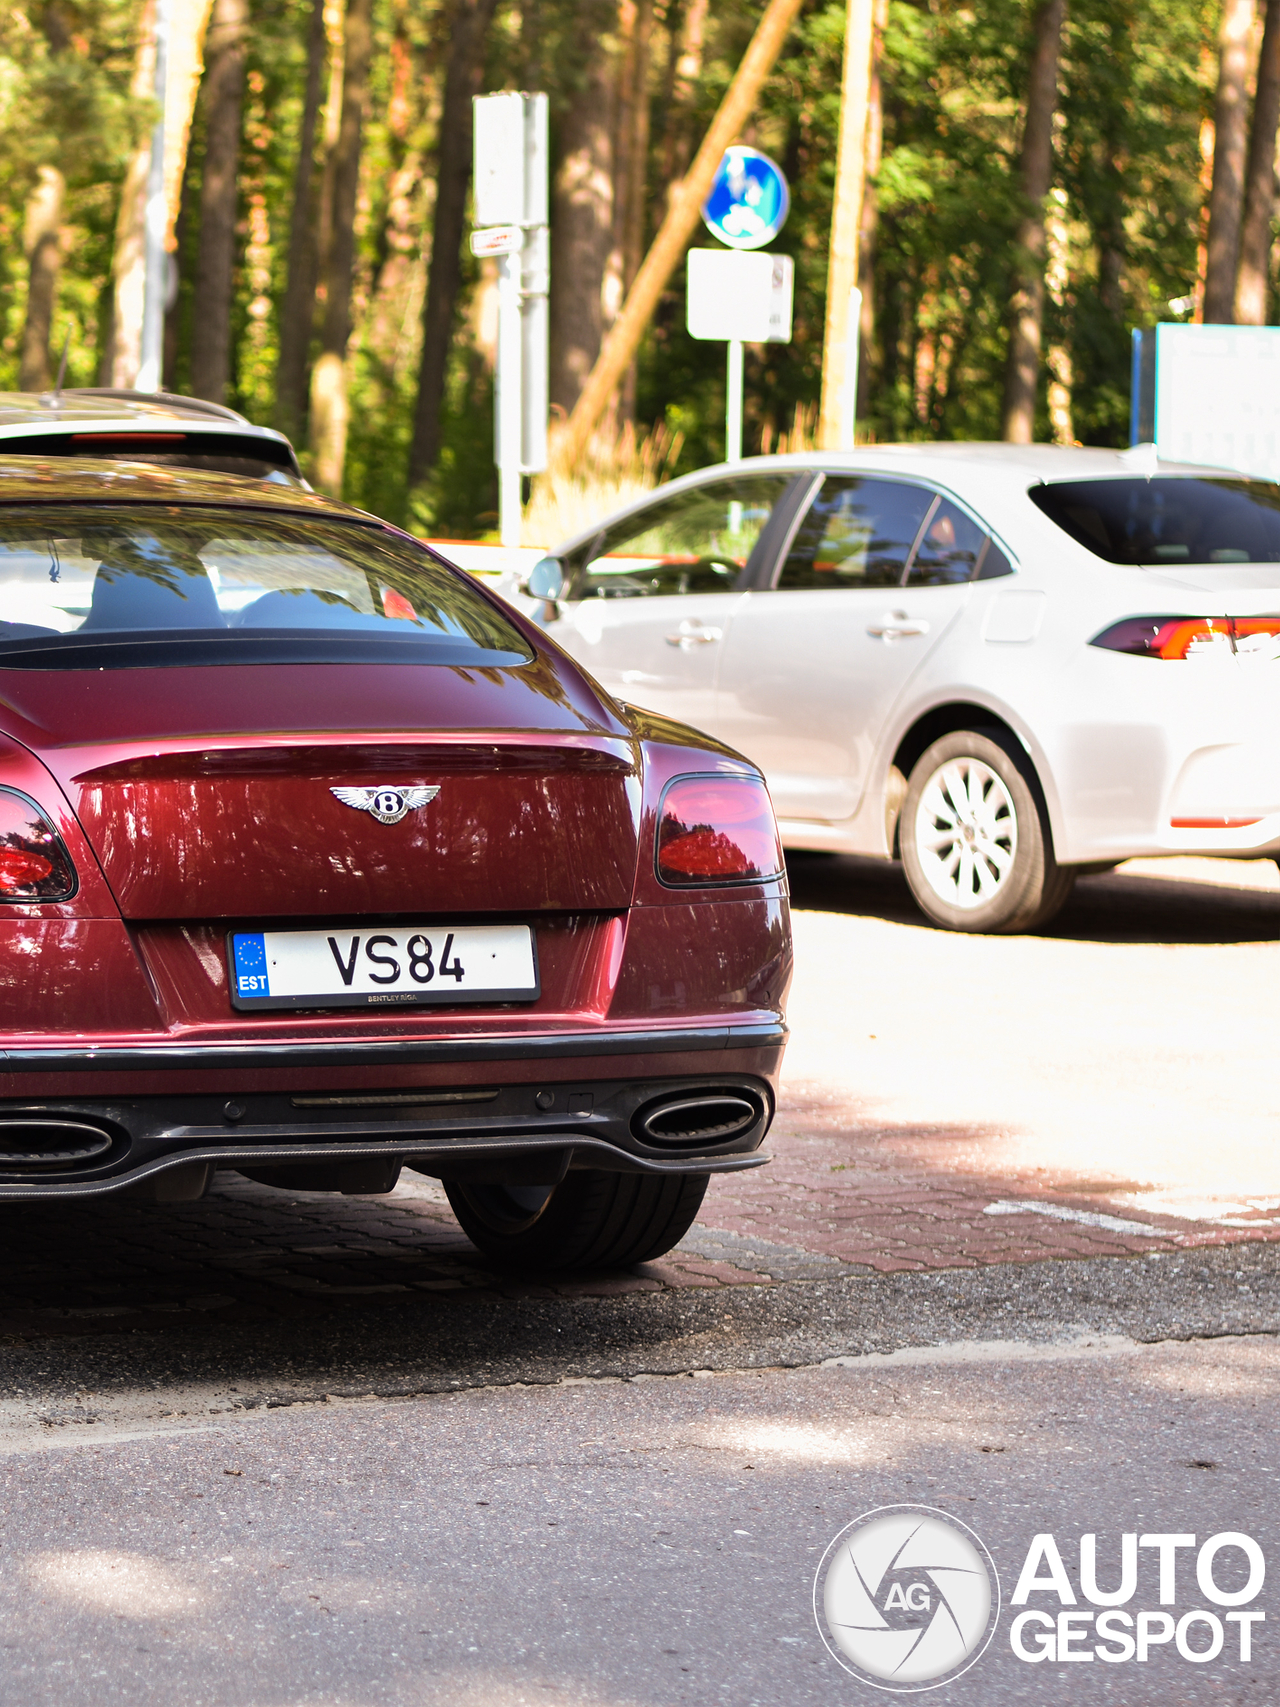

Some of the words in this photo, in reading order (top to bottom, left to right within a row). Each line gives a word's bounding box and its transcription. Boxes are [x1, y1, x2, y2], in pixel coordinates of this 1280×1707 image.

[377, 794, 399, 814] B
[327, 933, 465, 986] VS84
[238, 975, 267, 991] EST
